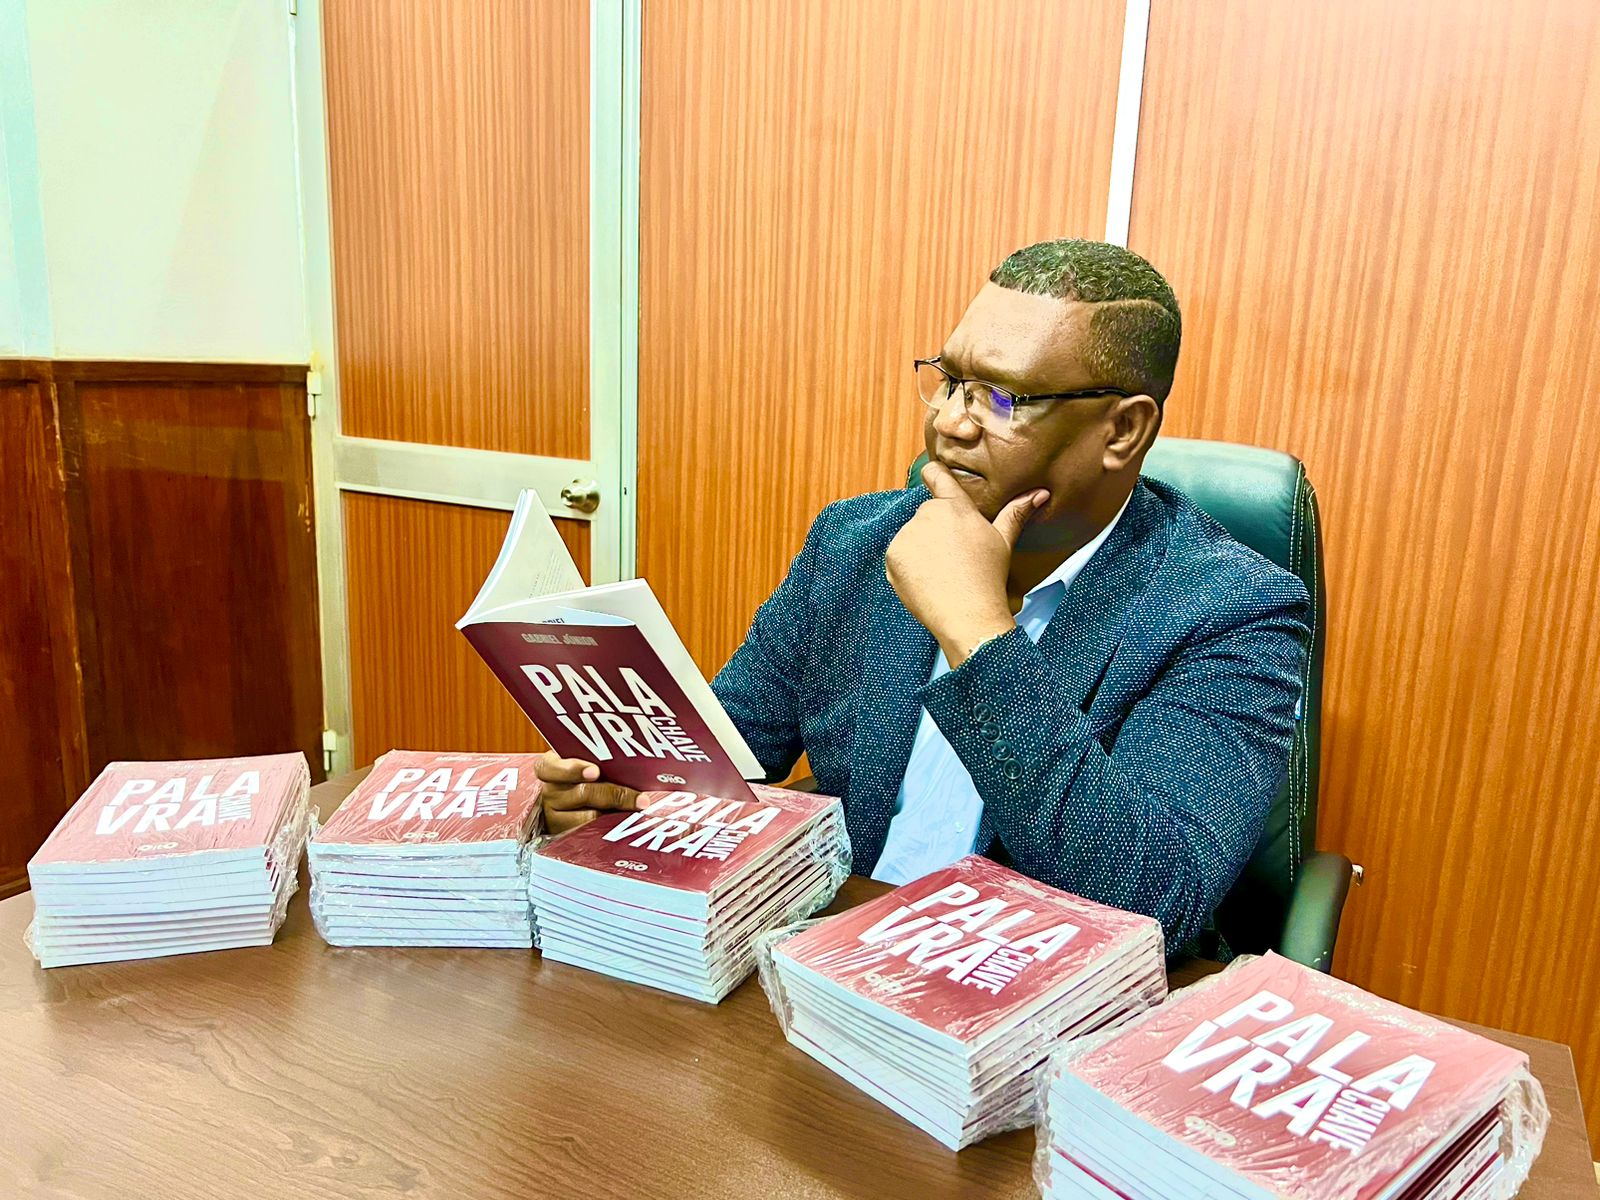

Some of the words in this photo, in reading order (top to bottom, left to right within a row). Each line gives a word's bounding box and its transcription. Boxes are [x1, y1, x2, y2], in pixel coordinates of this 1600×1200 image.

[519, 664, 676, 718] PALA
[556, 712, 688, 762] VRA
[650, 715, 712, 763] CHAVE
[109, 770, 260, 806] PALA
[382, 767, 519, 793] PALA
[95, 798, 217, 835] VRA
[367, 791, 479, 820] VRA
[641, 791, 783, 835] PALA
[602, 812, 722, 858] VRA
[694, 828, 749, 862] CHAVE
[858, 905, 1000, 983] VRA
[910, 881, 1081, 962] PALA
[961, 947, 1035, 996] CHAVE
[1211, 989, 1436, 1112] PALA
[1161, 1019, 1343, 1139] VRA
[1309, 1088, 1391, 1155] CHAVE
